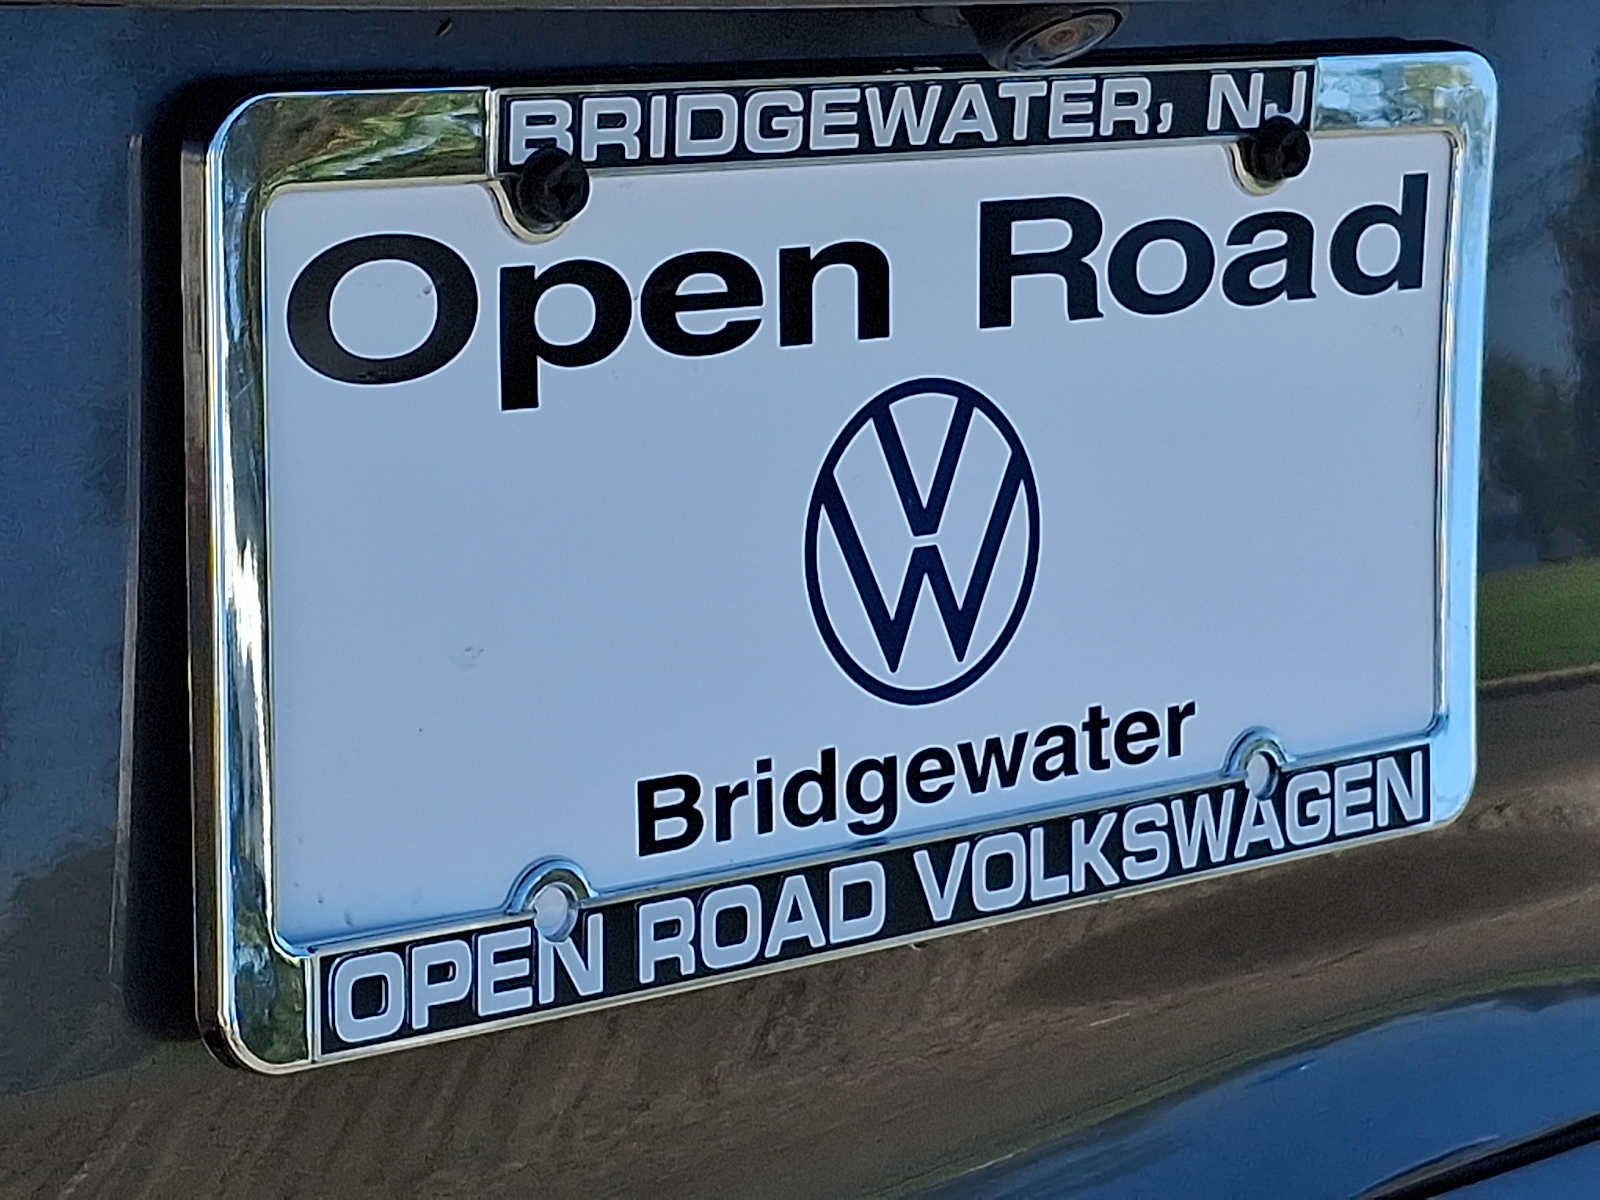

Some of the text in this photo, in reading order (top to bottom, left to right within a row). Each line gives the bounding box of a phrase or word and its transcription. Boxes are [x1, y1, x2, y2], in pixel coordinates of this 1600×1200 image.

[509, 70, 1307, 165] BRIDGEWATER, NJ
[287, 173, 1428, 411] Open Road
[637, 701, 1196, 857] Bridgewater
[333, 750, 1424, 1044] OPEN ROAD VOLKSWAGEN
